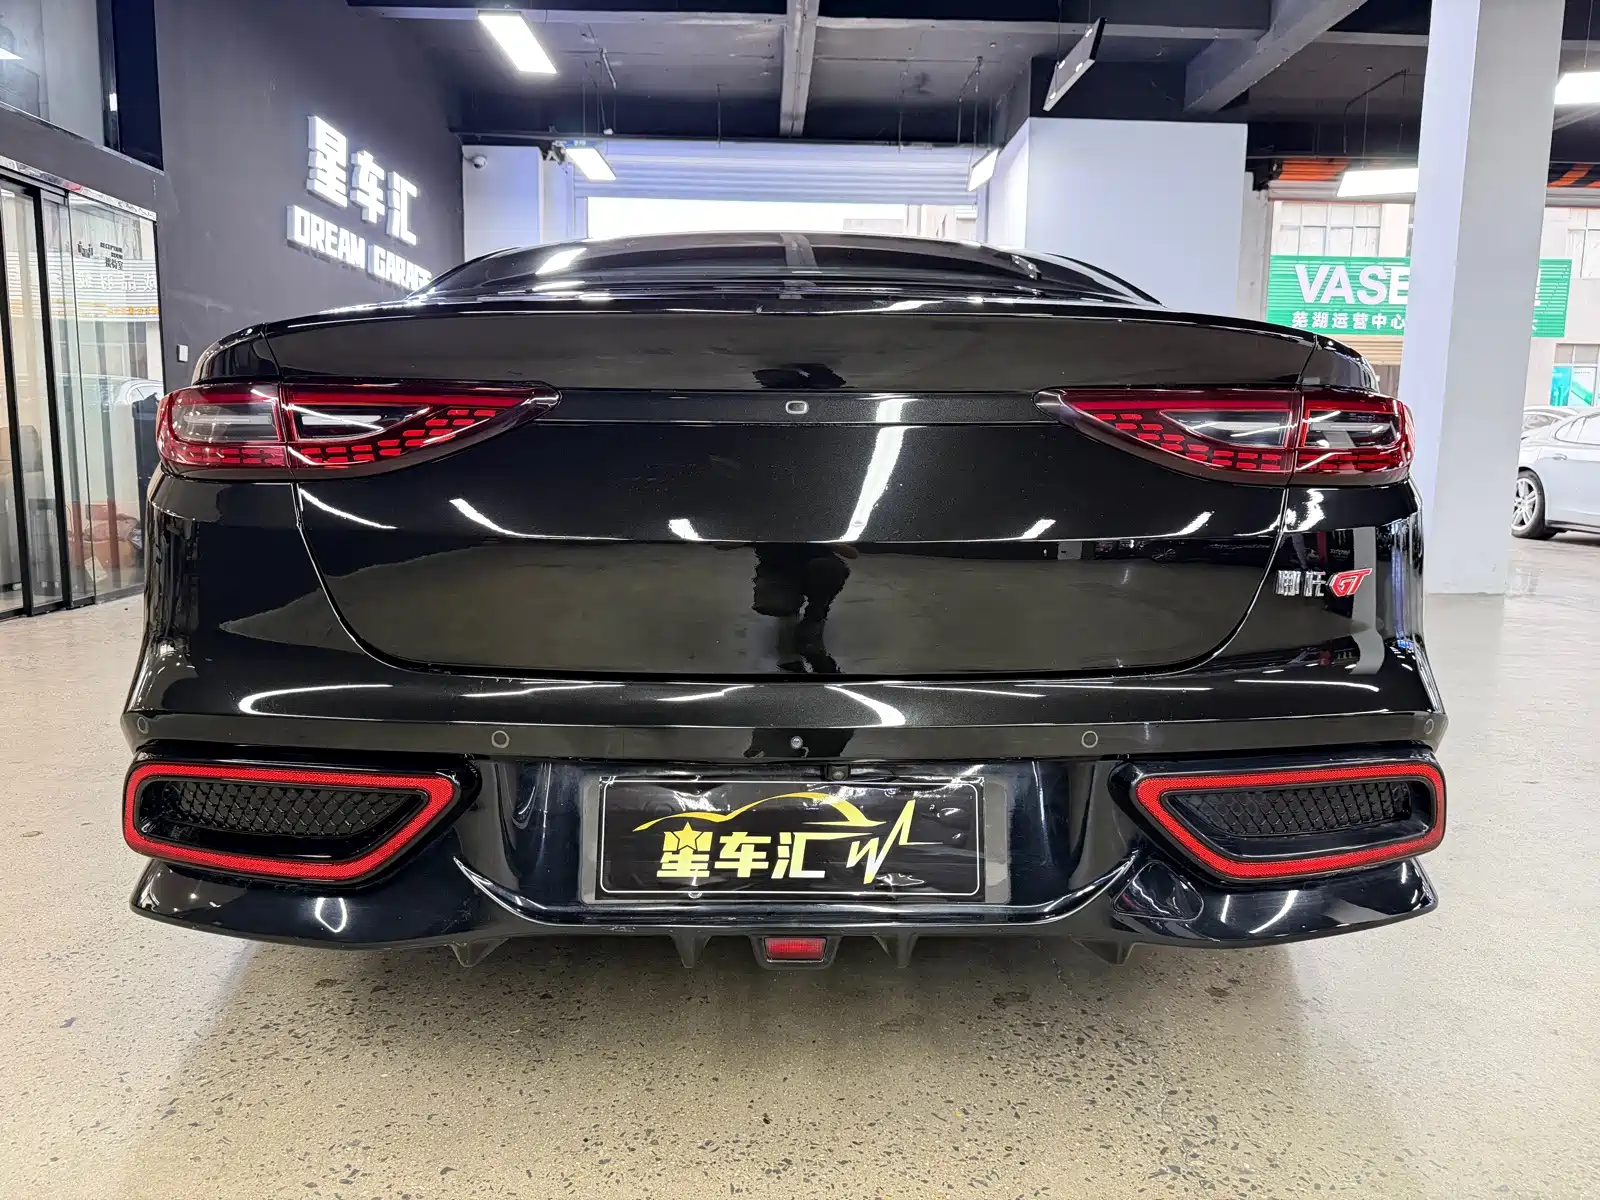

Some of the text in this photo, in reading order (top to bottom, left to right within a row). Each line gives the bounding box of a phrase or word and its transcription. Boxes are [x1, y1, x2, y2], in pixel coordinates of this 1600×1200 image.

[307, 115, 418, 246] 星车汇
[287, 204, 366, 270] DREAM
[1291, 311, 1406, 330] 芜湖运营中心
[1329, 567, 1373, 598] GT
[656, 821, 872, 880] 星车汇
